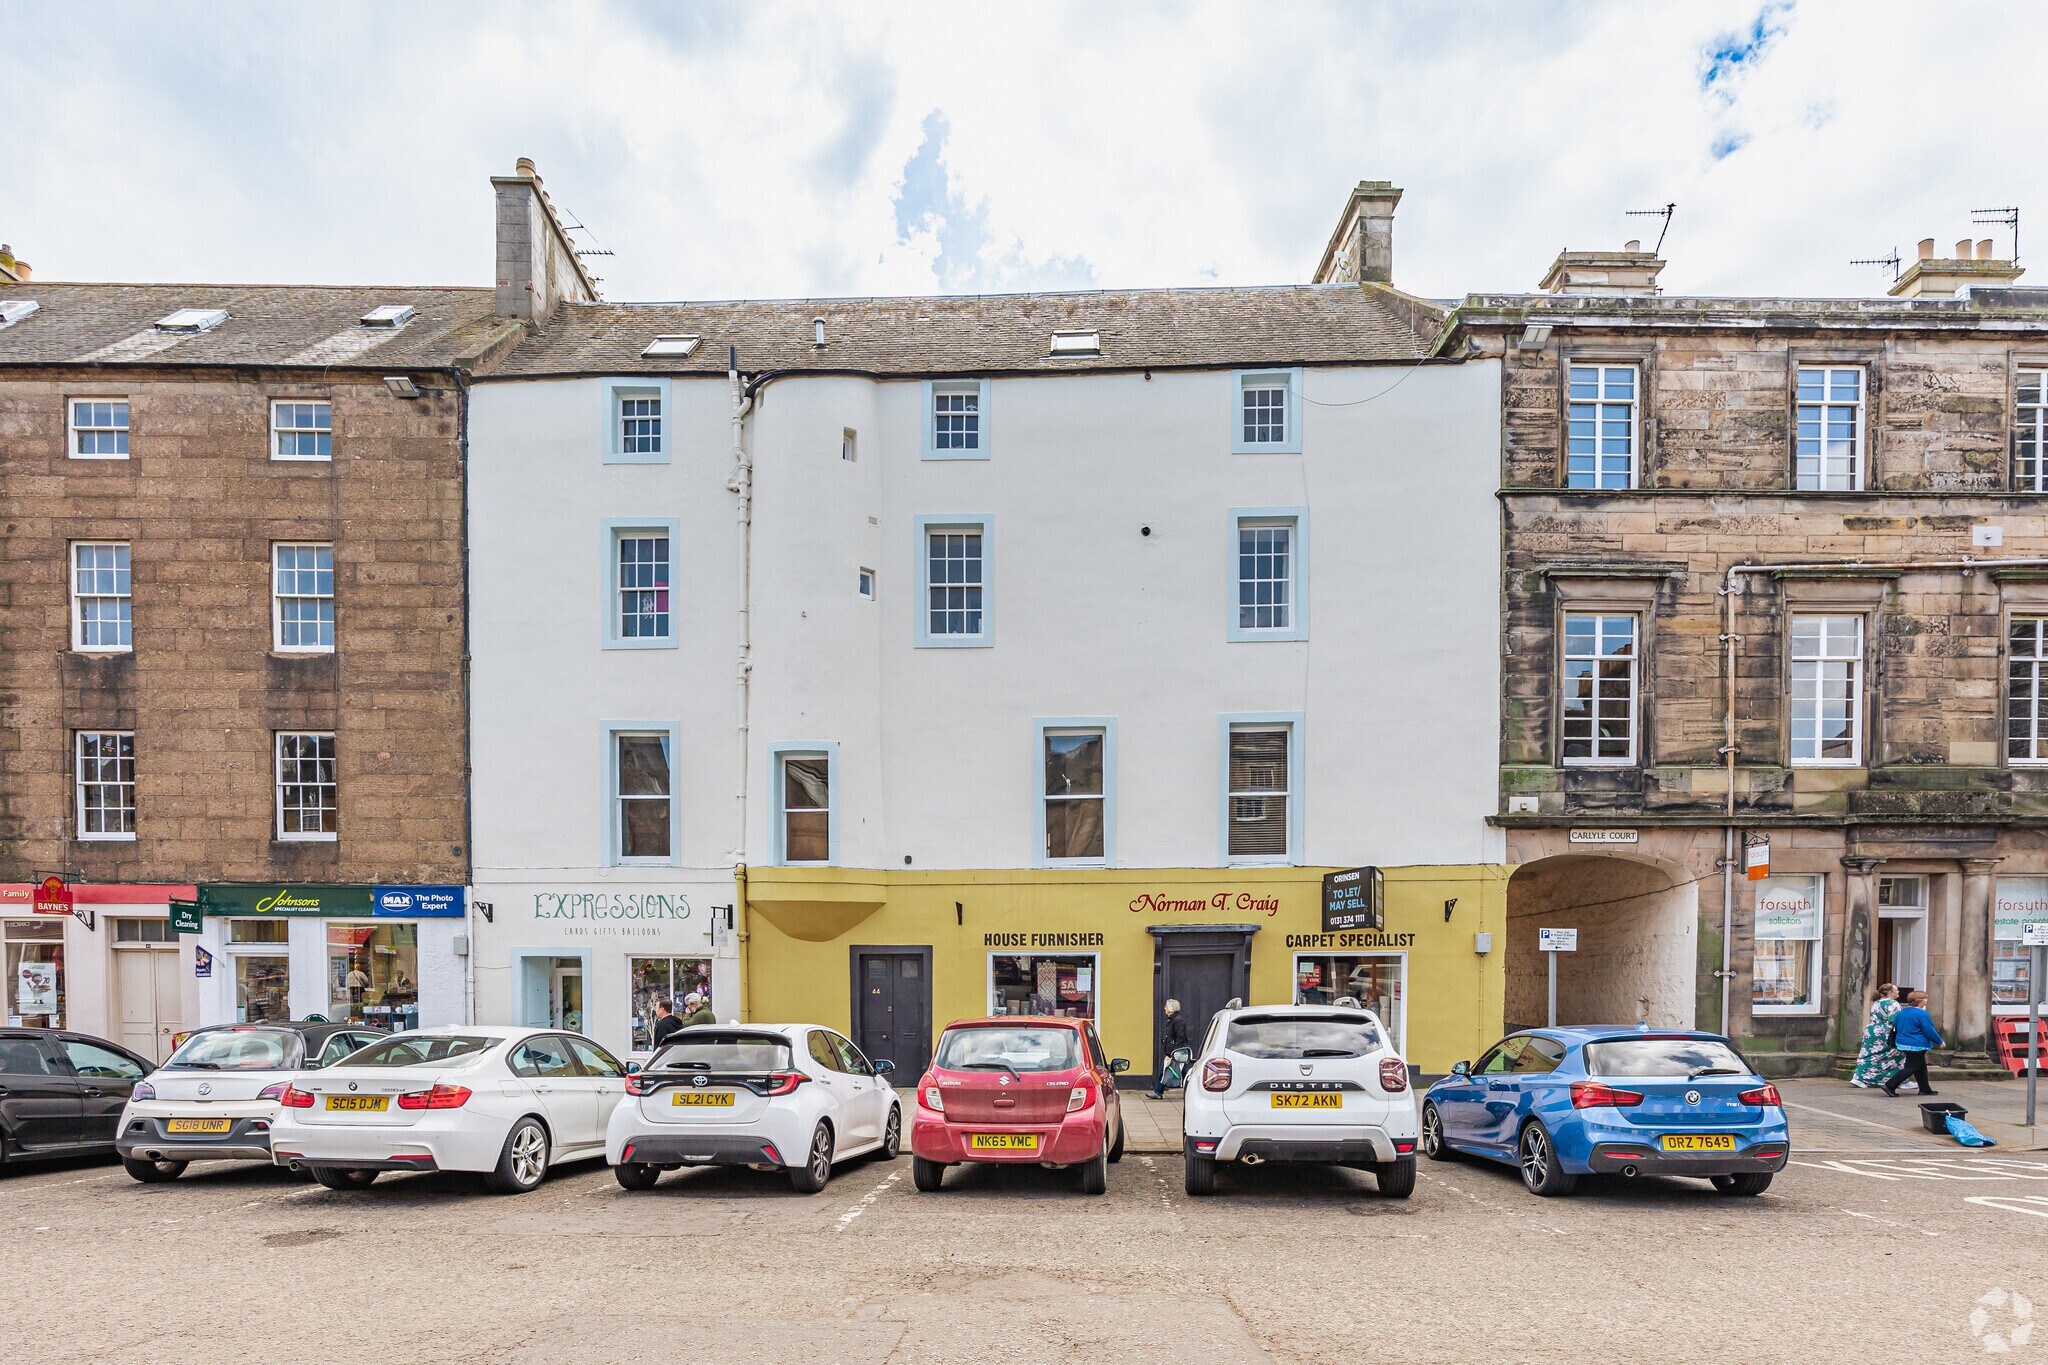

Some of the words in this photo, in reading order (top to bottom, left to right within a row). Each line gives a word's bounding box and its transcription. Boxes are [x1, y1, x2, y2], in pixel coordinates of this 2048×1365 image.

[1748, 850, 1768, 861] forsyth
[1334, 872, 1360, 883] ORINSEN
[3, 890, 30, 899] Family
[1333, 888, 1343, 899] TO
[1345, 885, 1361, 897] LET/
[255, 889, 320, 912] Johnsons
[383, 896, 410, 905] MAX
[415, 894, 431, 902] The
[433, 894, 454, 902] Photo
[38, 902, 69, 912] BAYNE'S
[422, 902, 448, 910] Expert
[1129, 893, 1207, 913] Norman
[1211, 893, 1233, 911] T.
[1236, 893, 1279, 917] Craig
[1330, 901, 1346, 911] MAY
[1347, 898, 1365, 909] SELL
[1760, 898, 1811, 915] forsyth
[1997, 898, 2048, 917] forsyth
[181, 911, 193, 920] Dry
[1330, 916, 1342, 925] 0131
[1343, 915, 1354, 924] 374
[1355, 914, 1365, 922] 1111
[1768, 916, 1802, 925] solicitors
[175, 920, 199, 930] Cleaning
[1994, 918, 2019, 926] estate
[564, 927, 588, 936] CARDS
[593, 927, 617, 936] GIFTS
[622, 927, 662, 936] BALLOONS
[984, 933, 1027, 947] HOUSE
[1031, 932, 1104, 946] FURNISHER
[1286, 934, 1335, 947] CARPET
[1340, 933, 1416, 947] SPECIALIST
[332, 1098, 357, 1110] SC15
[359, 1098, 382, 1110] OJM
[679, 1094, 704, 1105] SL21
[706, 1094, 729, 1105] CYK
[1276, 1095, 1309, 1106] SK72
[1313, 1095, 1338, 1106] AKN
[175, 1120, 199, 1131] SG18
[201, 1120, 224, 1130] UNR
[976, 1135, 1007, 1147] NK65
[1010, 1135, 1032, 1147] VMC
[1668, 1136, 1694, 1149] ORZ
[1696, 1136, 1730, 1148] 7649
